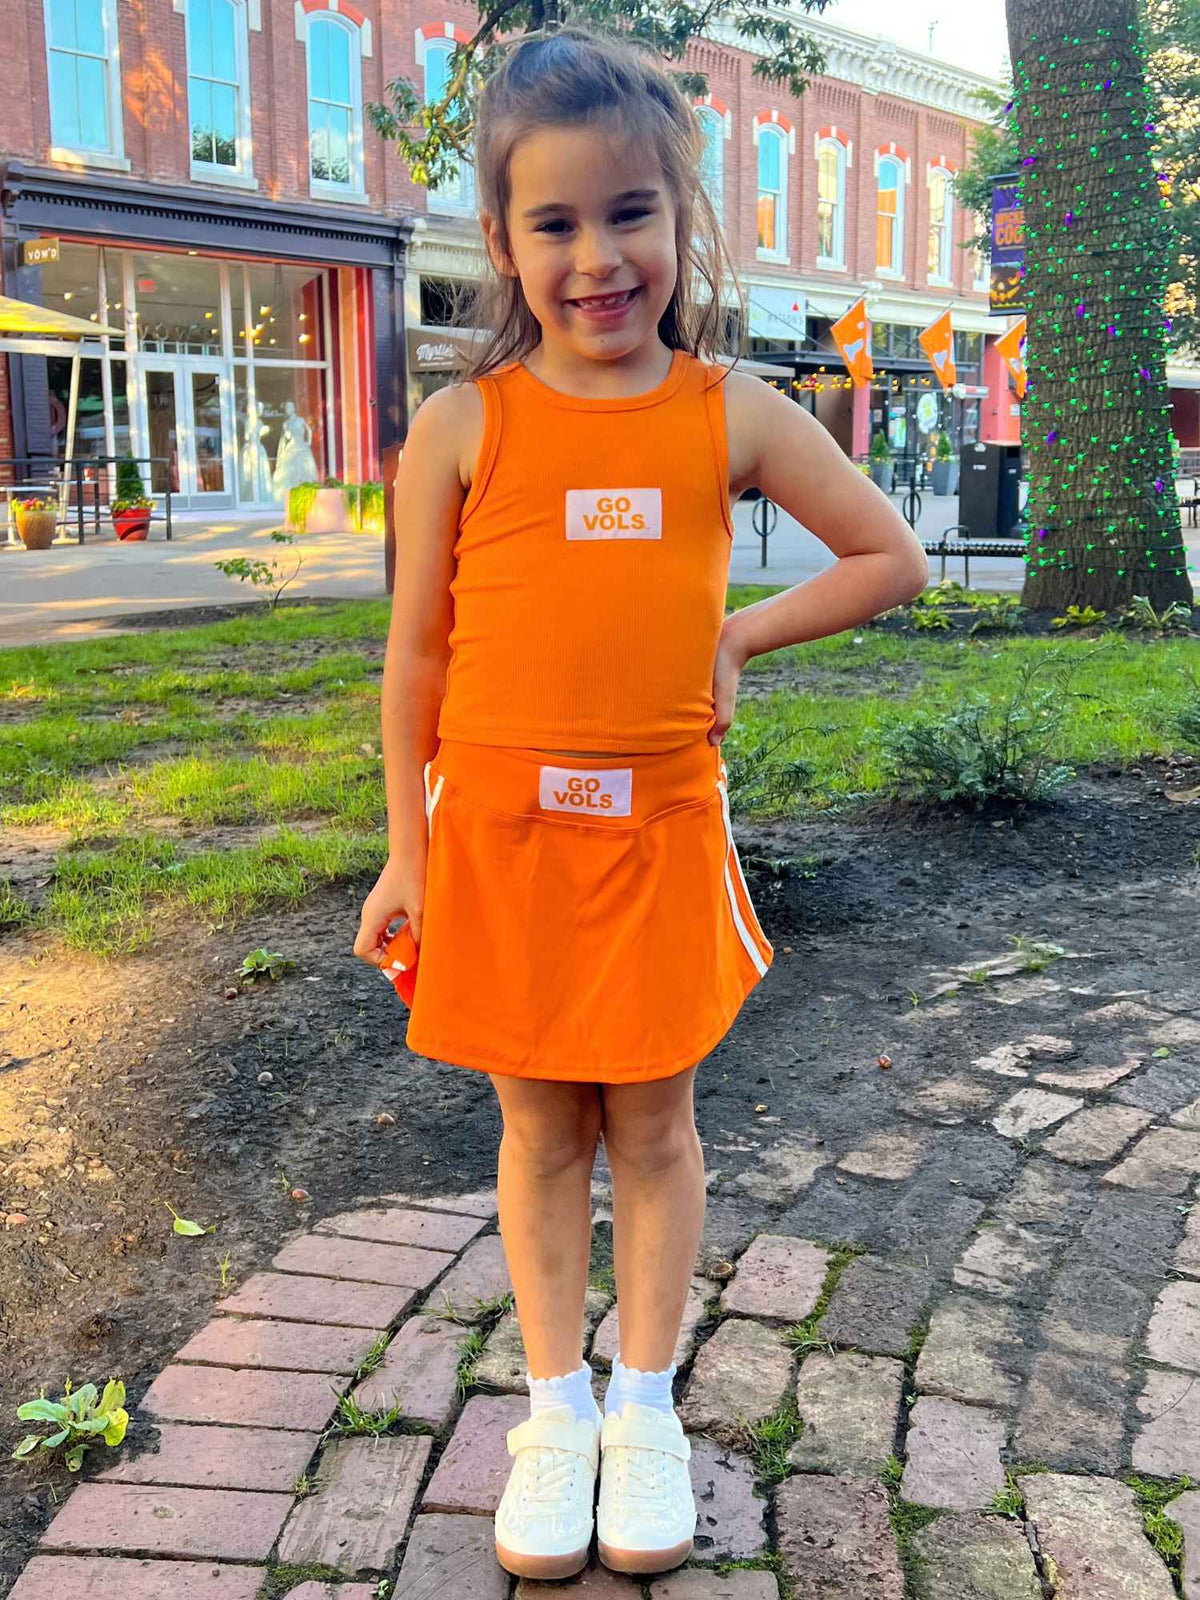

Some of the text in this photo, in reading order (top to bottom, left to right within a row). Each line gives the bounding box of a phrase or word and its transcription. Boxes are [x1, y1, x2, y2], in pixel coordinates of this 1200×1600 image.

[597, 498, 631, 513] GO
[583, 514, 645, 530] VOLS
[567, 778, 600, 792] GO
[553, 791, 613, 809] VOLS
